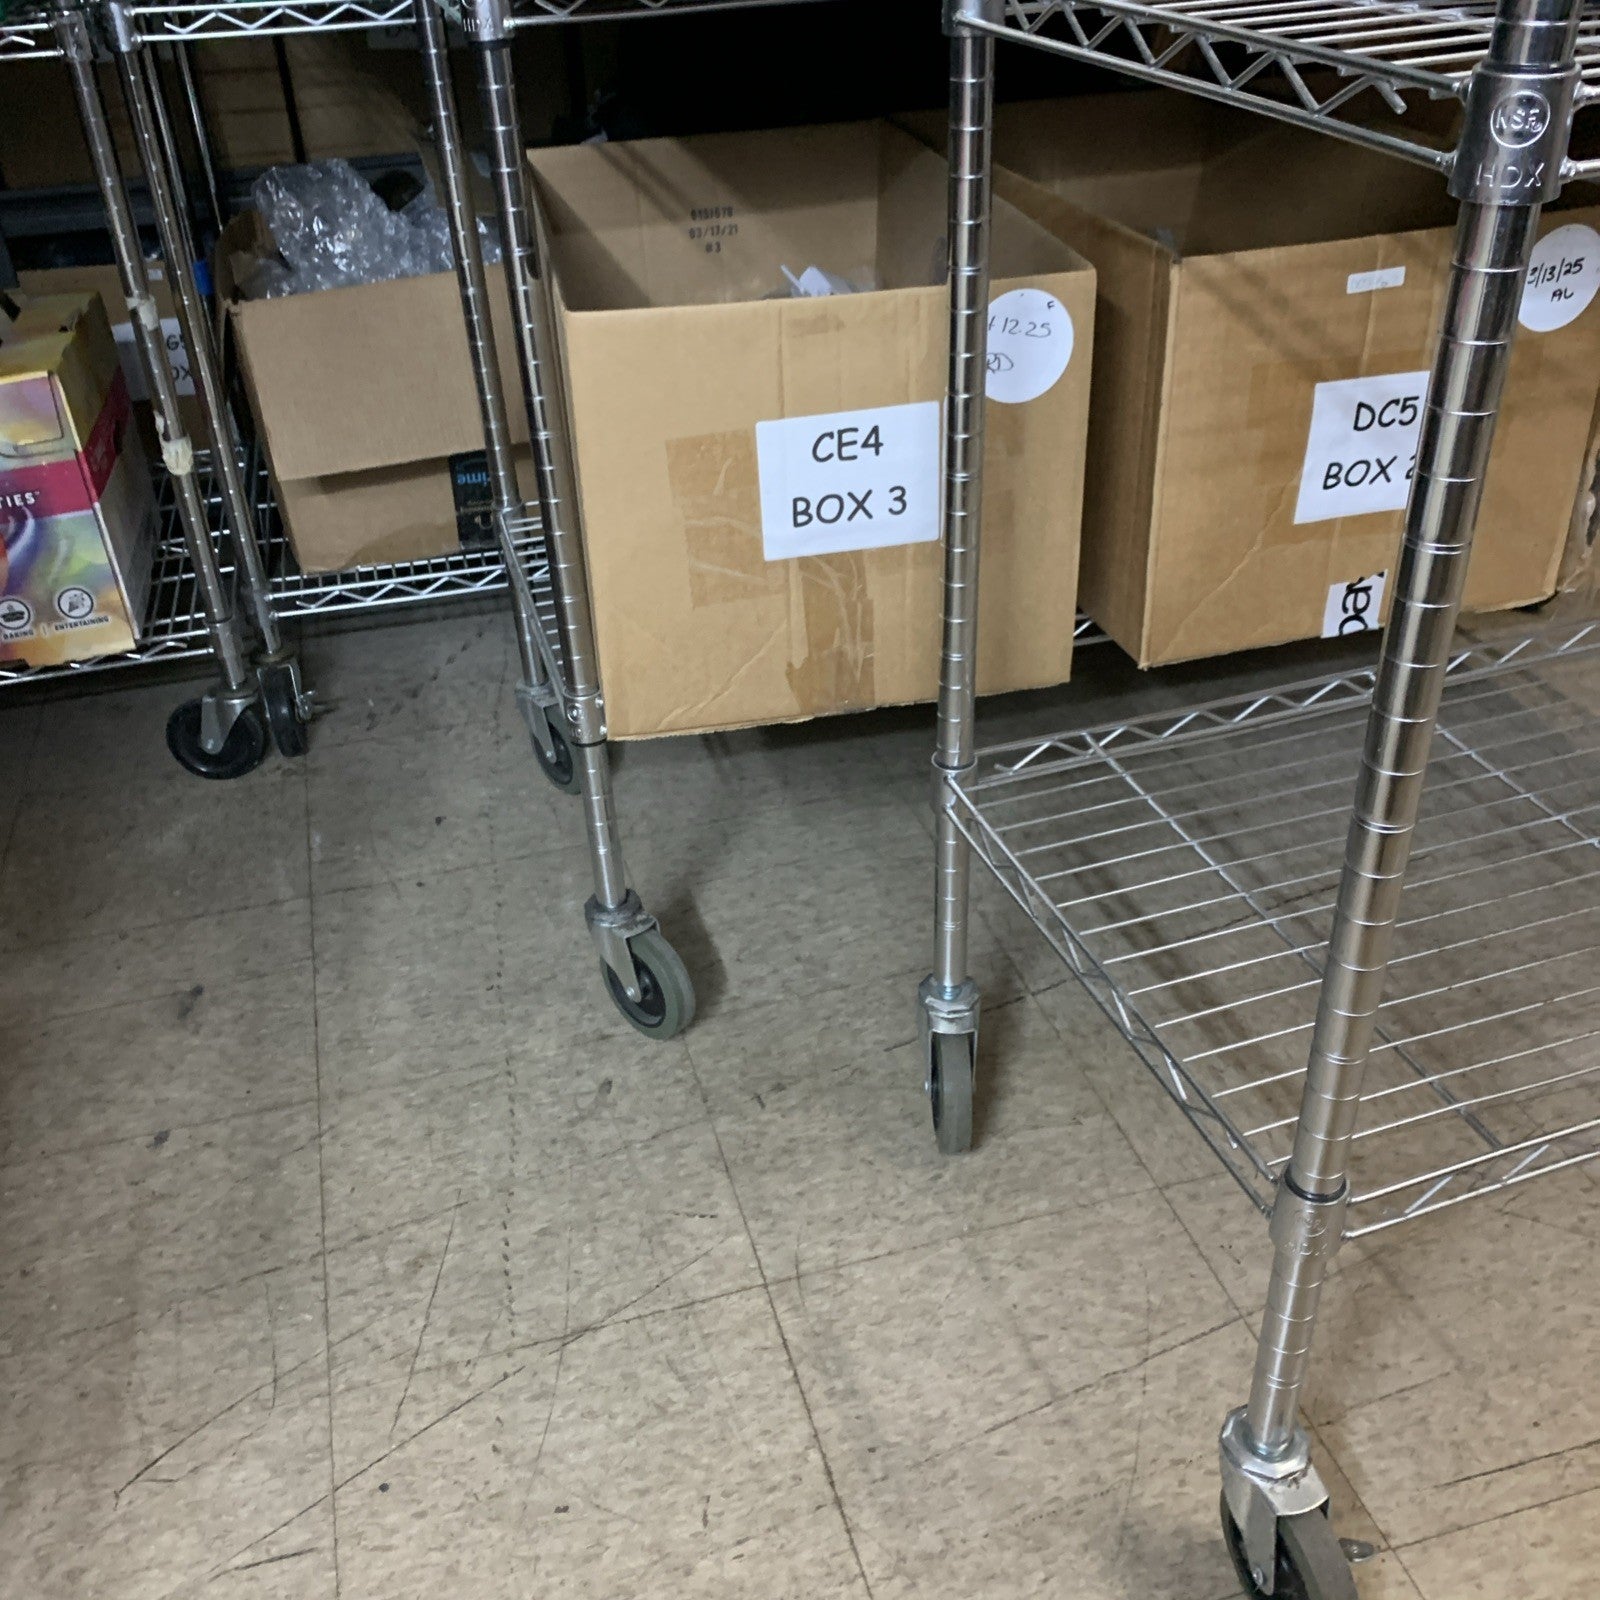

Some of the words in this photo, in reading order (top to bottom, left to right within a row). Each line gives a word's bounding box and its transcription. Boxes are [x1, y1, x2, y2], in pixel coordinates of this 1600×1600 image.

[1476, 162, 1545, 188] HDX
[1353, 396, 1420, 432] DC5
[812, 425, 884, 463] CE4
[1322, 455, 1398, 490] BOX
[792, 489, 873, 528] BOX
[888, 485, 907, 515] 3
[54, 615, 109, 631] ENTERTAINING
